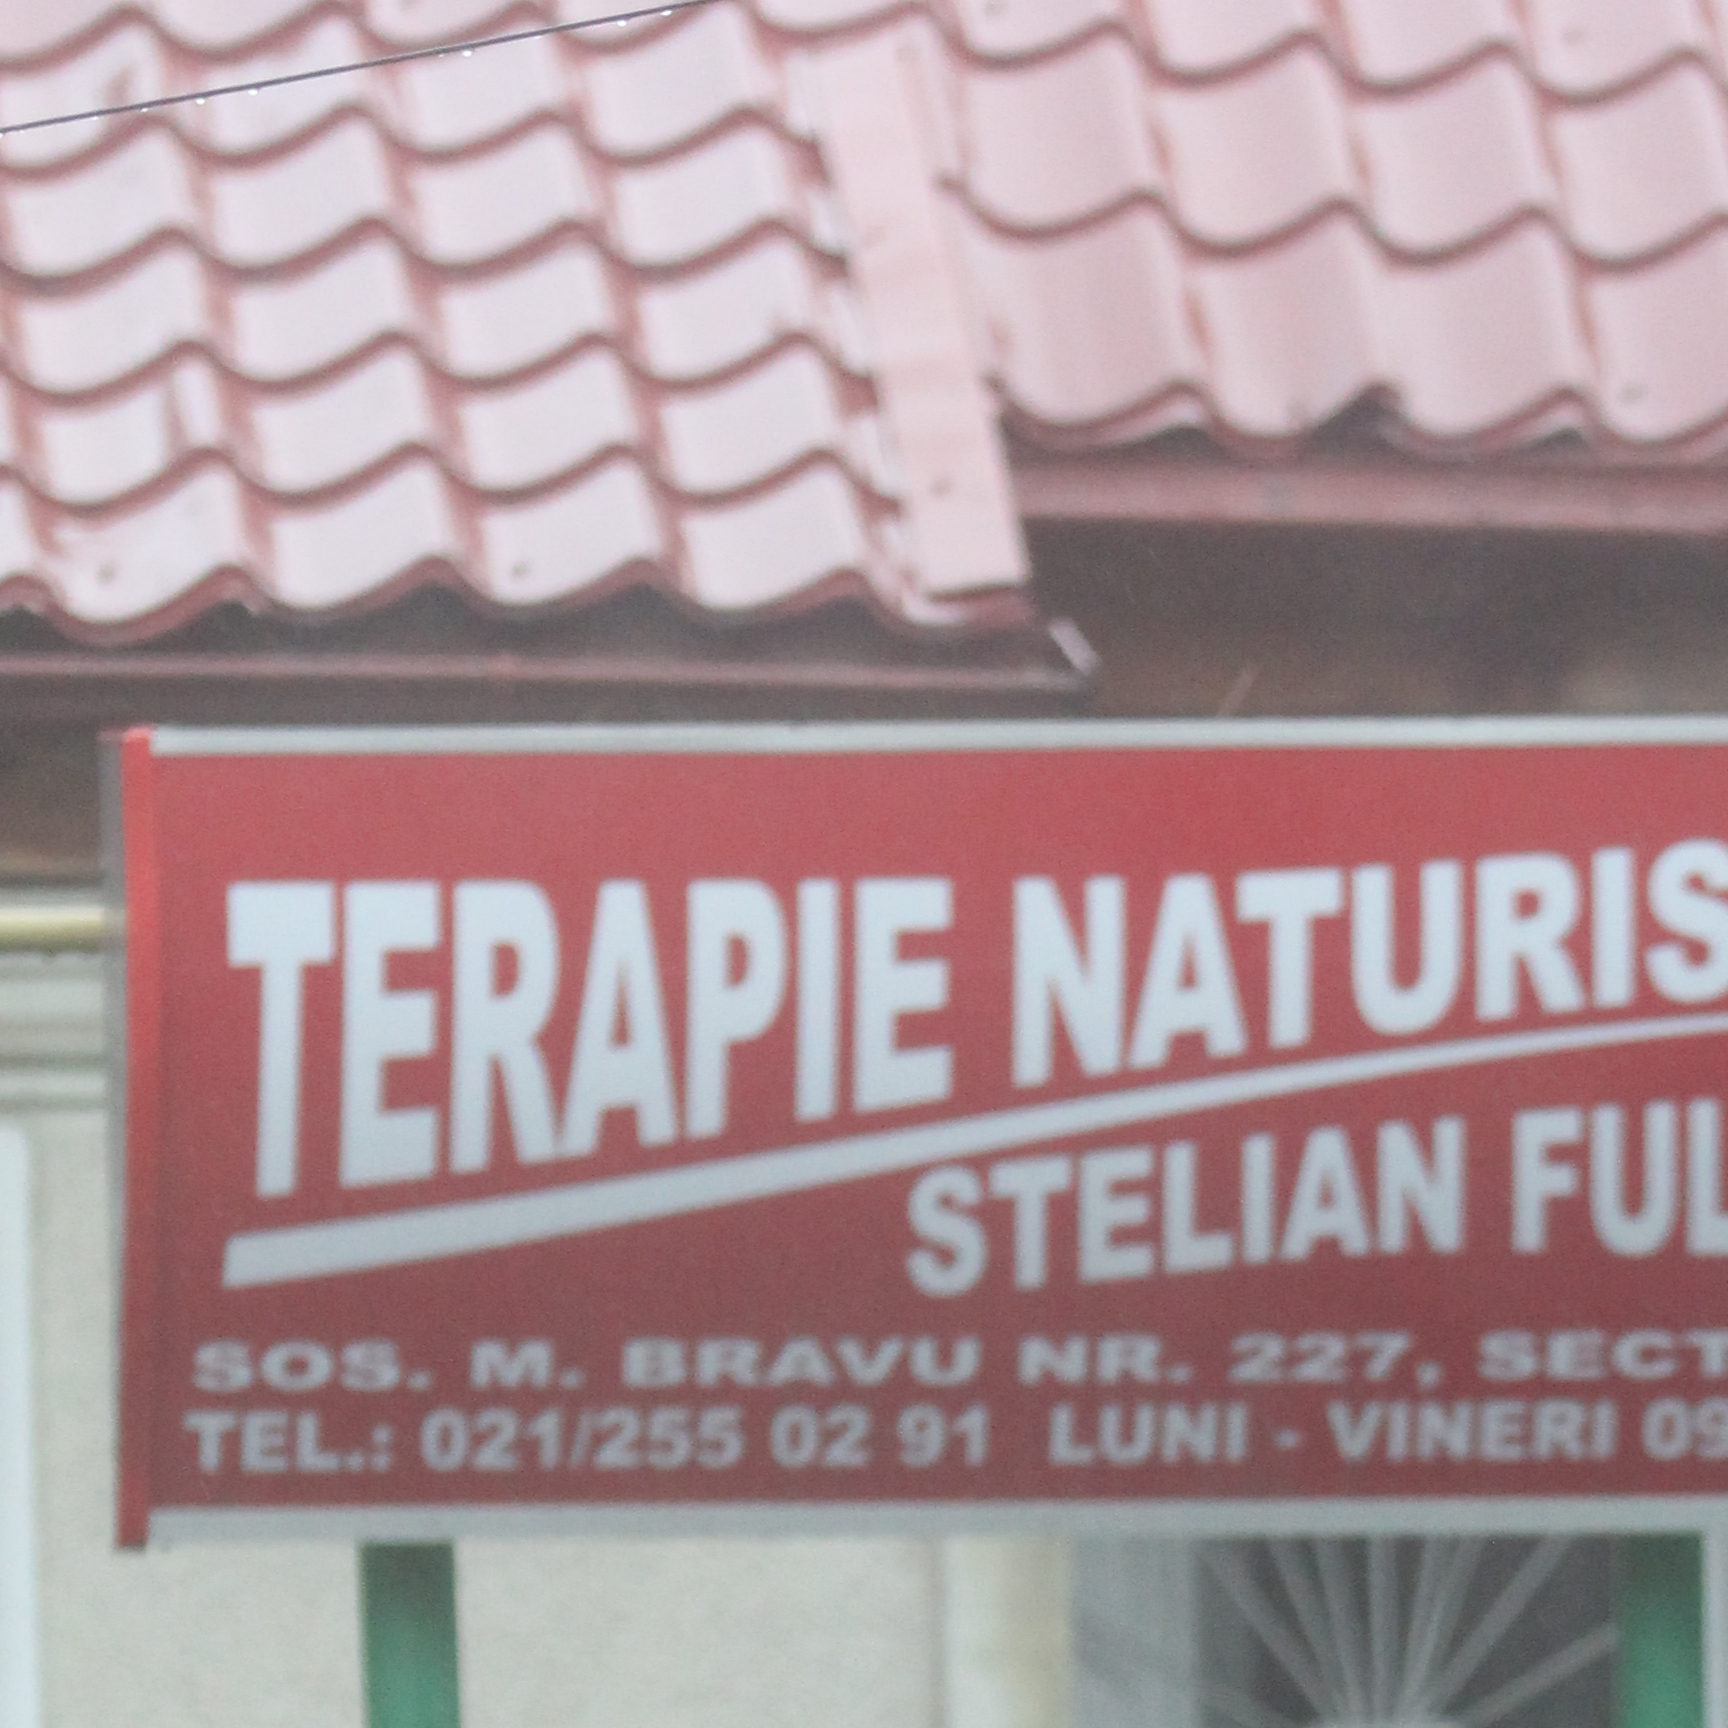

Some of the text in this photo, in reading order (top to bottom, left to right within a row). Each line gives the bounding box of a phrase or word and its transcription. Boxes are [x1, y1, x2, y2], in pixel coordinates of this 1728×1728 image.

[227, 877, 953, 1198] TERAPIE
[906, 1113, 1466, 1298] STELIAN
[195, 1339, 430, 1392] SOS.
[470, 1340, 582, 1389] M.
[623, 1335, 981, 1388] BRAVU
[1018, 1334, 1189, 1385] NR.
[1229, 1331, 1440, 1389] 227,
[184, 1409, 392, 1474] TEL.:
[421, 1405, 746, 1472] 021/255
[770, 1403, 871, 1468] 02
[896, 1404, 989, 1467] 91
[1049, 1402, 1248, 1465] LUNI
[1328, 1398, 1617, 1462] VINERI
